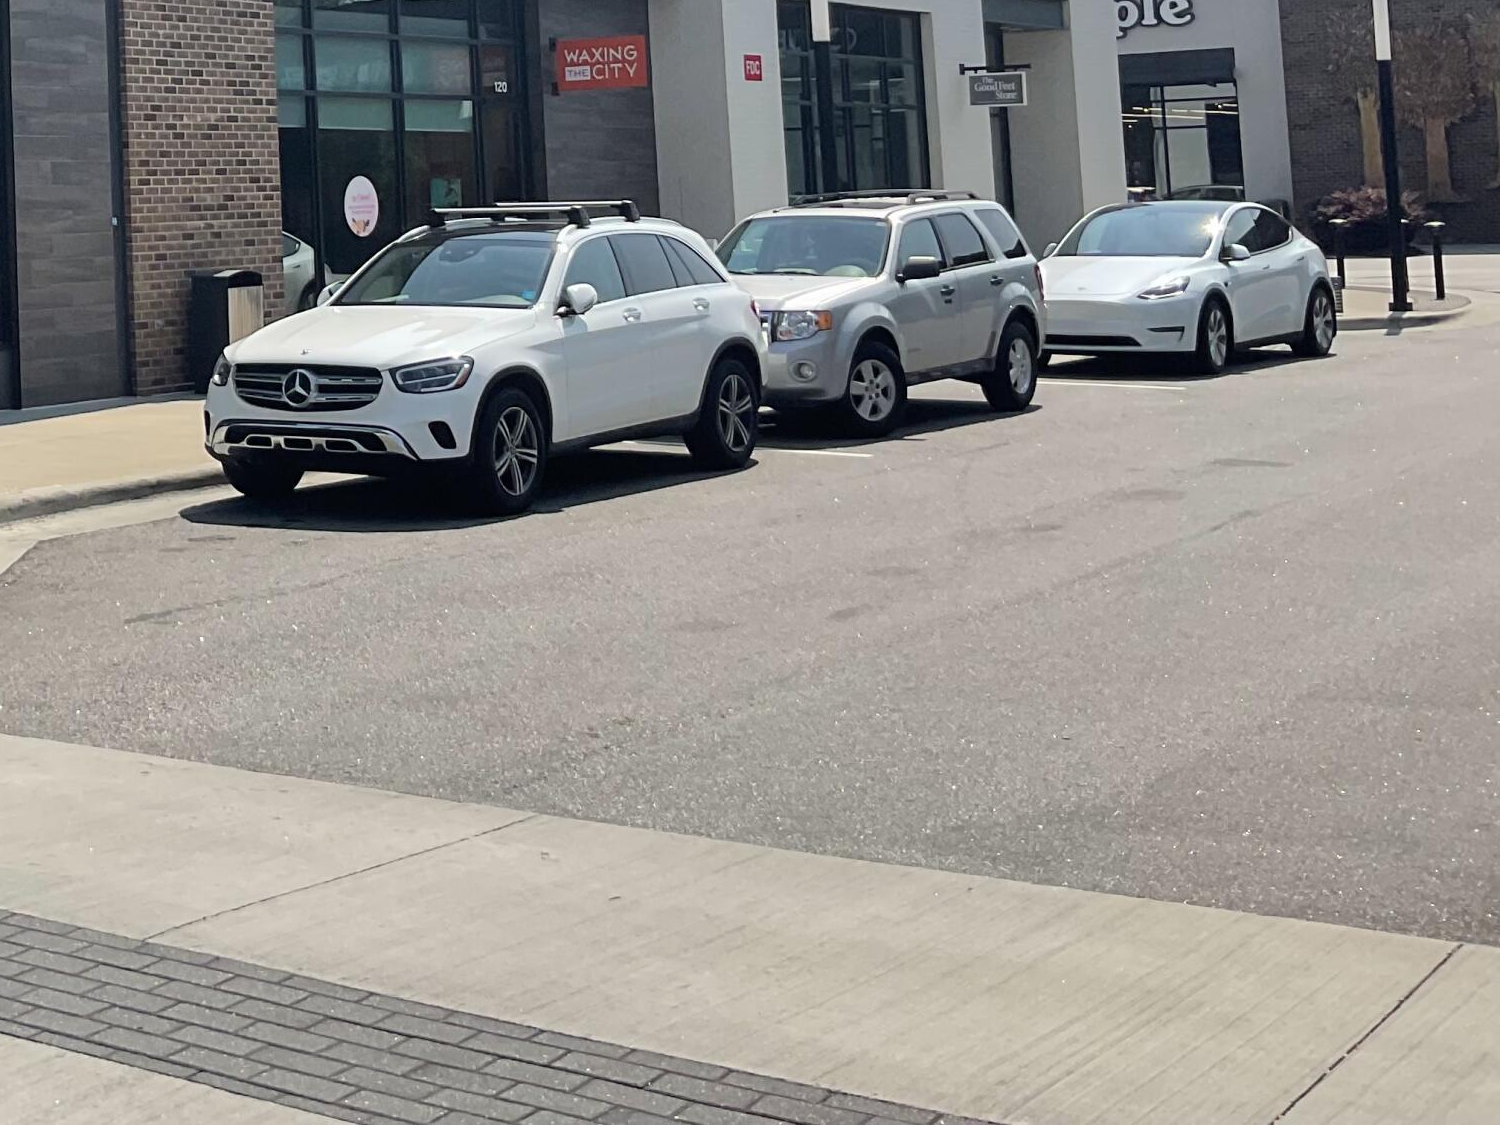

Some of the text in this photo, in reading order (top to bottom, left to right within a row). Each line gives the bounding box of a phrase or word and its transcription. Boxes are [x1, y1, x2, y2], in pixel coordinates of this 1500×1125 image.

[564, 45, 638, 64] WAXING
[566, 62, 638, 80] THE CITY
[974, 80, 1016, 92] Good Feet
[981, 76, 995, 84] The
[494, 81, 508, 93] 120
[996, 90, 1018, 100] Store
